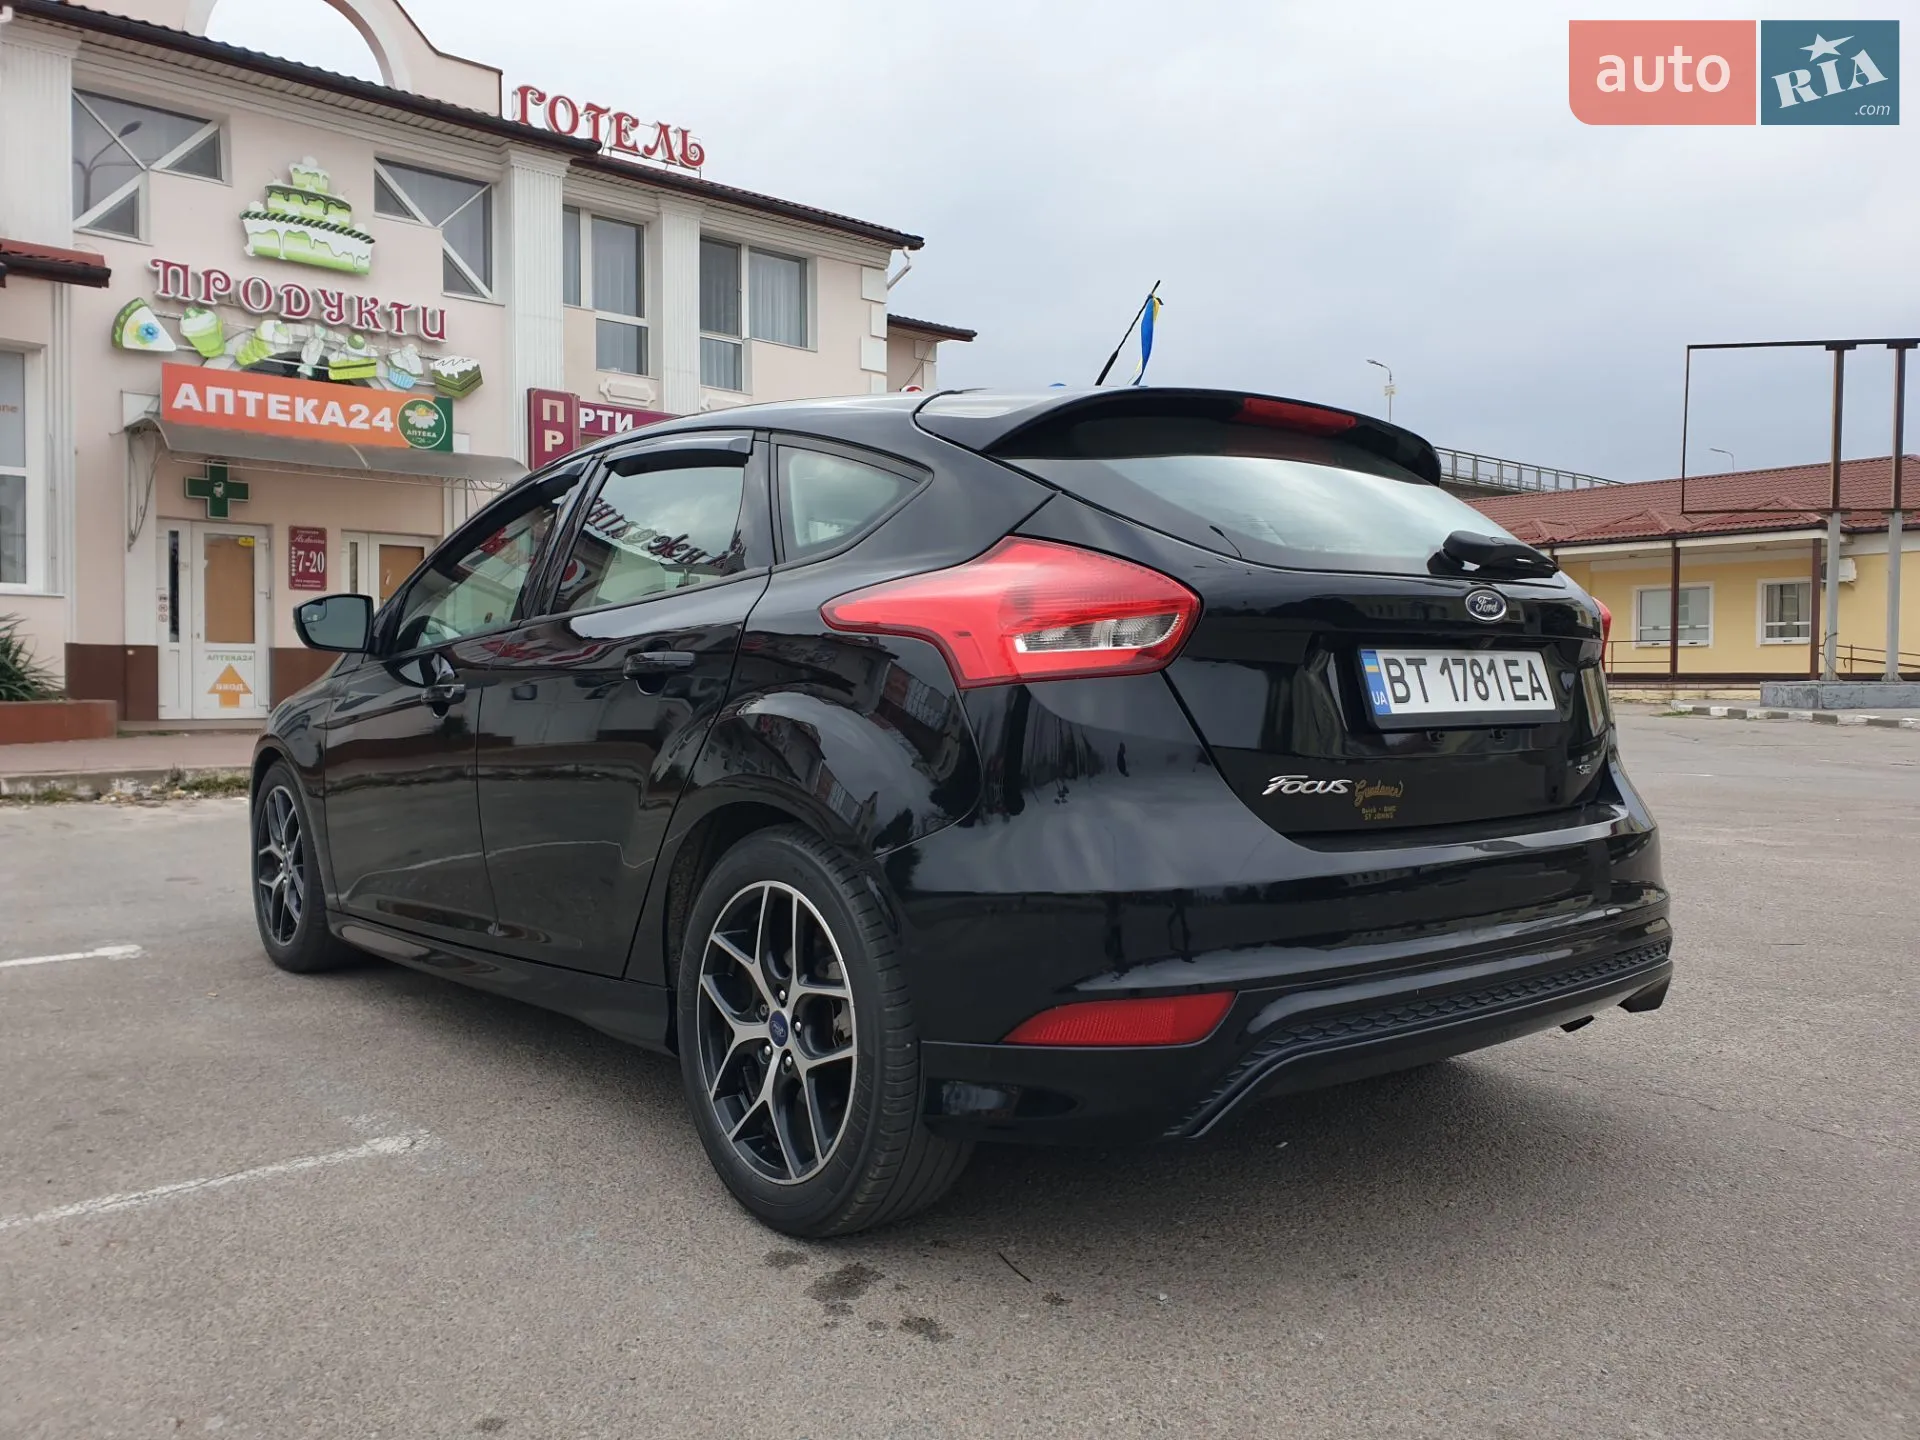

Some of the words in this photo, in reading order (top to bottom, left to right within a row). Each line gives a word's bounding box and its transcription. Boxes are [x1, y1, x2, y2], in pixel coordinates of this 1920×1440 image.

[513, 84, 705, 167] ГОТЕЛЬ
[149, 257, 449, 343] ПРОДУКТИ
[406, 429, 437, 438] АПТЕКА
[297, 550, 325, 573] 7-20
[1475, 595, 1498, 613] Ford
[1383, 657, 1430, 704] BT
[1372, 691, 1388, 706] UA
